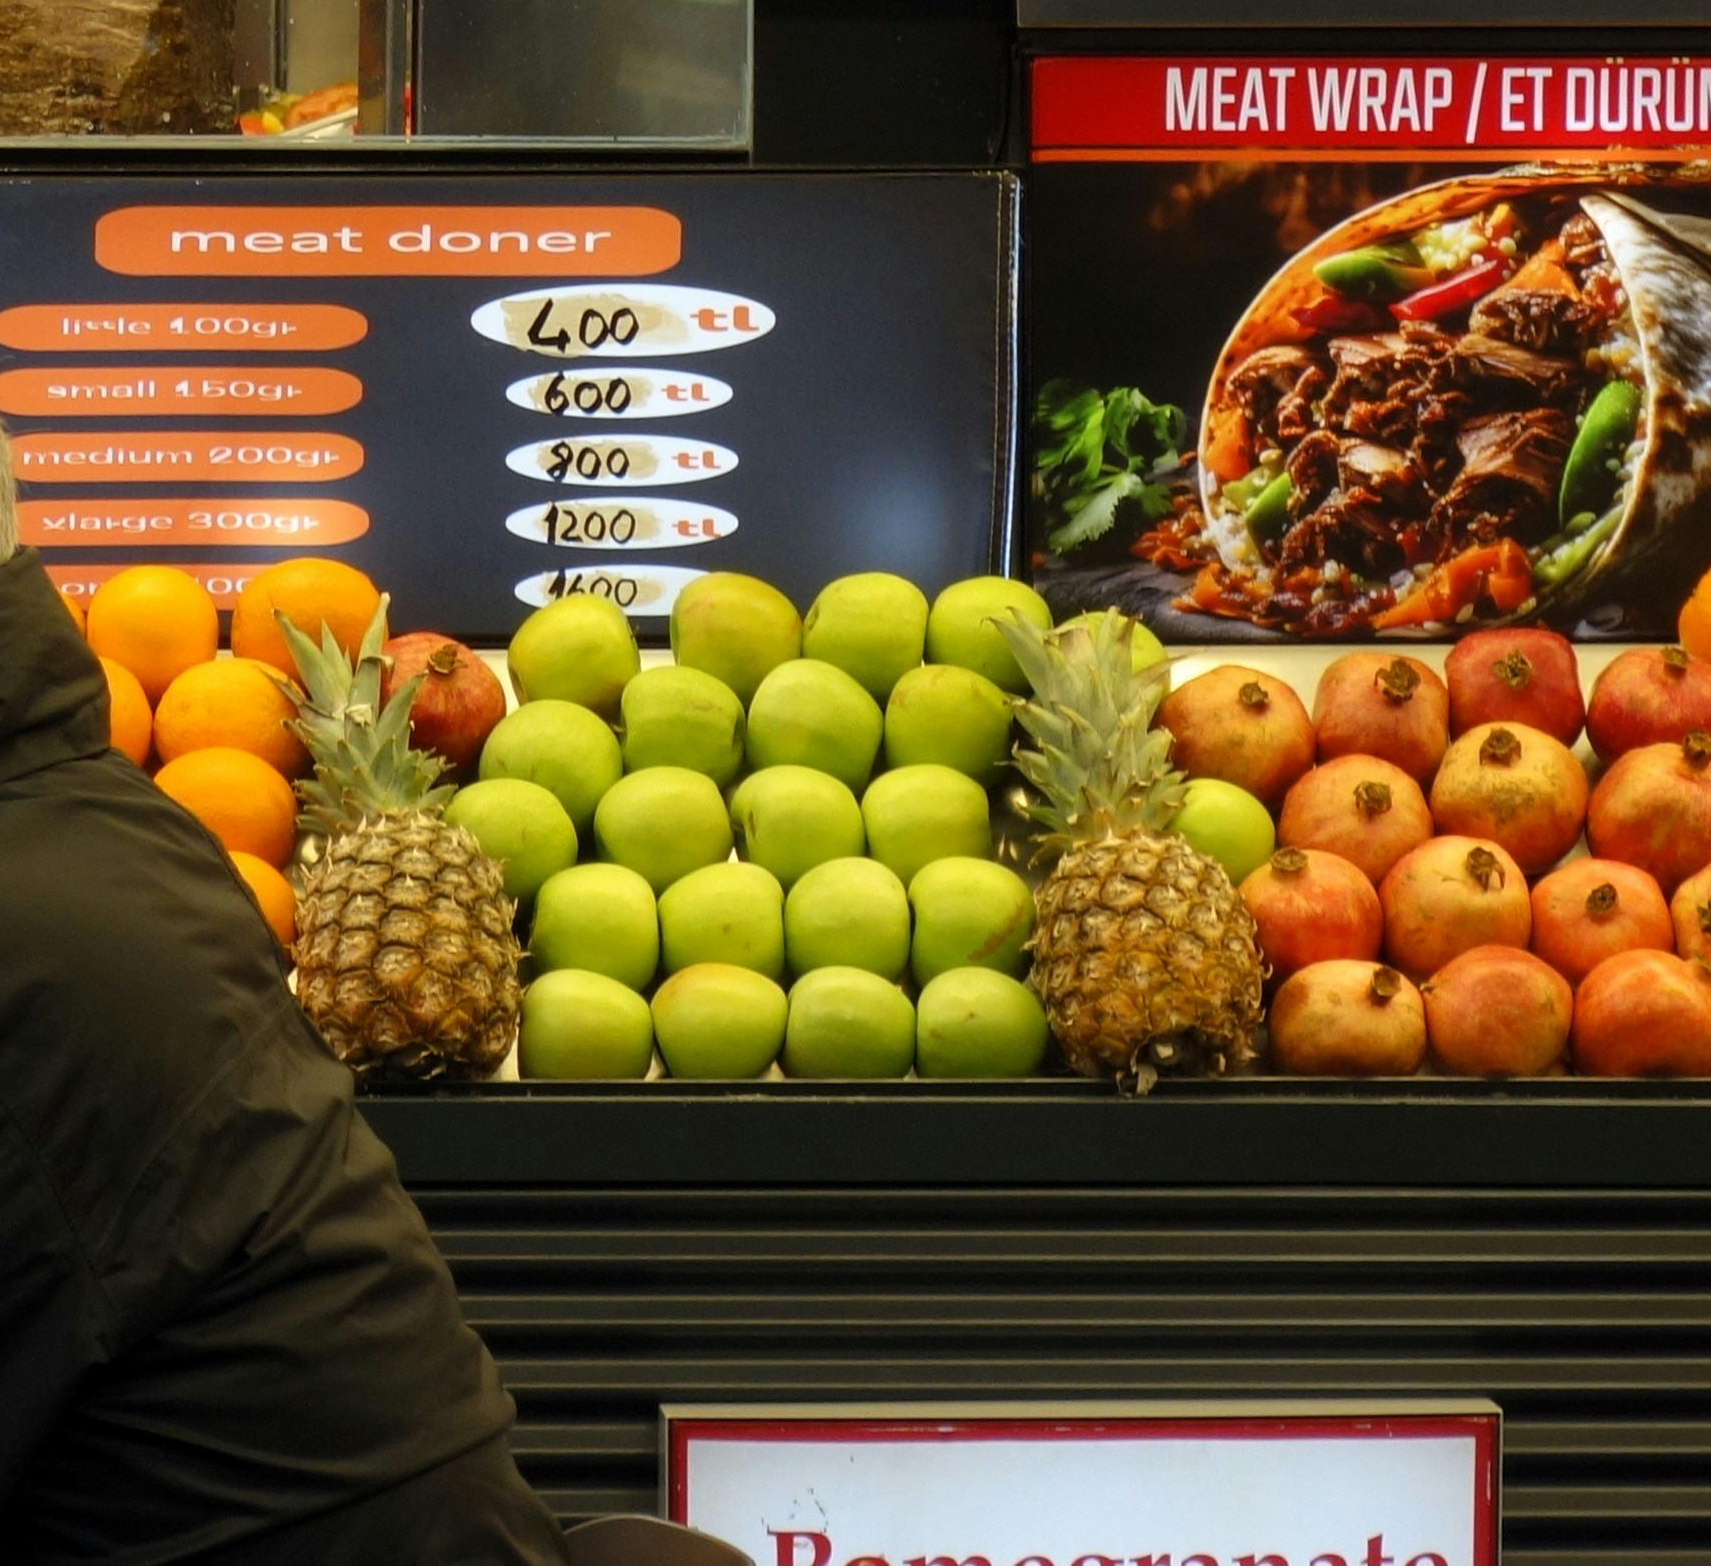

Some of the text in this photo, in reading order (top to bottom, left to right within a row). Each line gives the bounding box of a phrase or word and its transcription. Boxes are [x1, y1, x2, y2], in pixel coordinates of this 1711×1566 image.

[1165, 67, 1295, 131] MEAT
[1309, 67, 1453, 131] WRAP
[1466, 62, 1487, 144] /
[1501, 67, 1553, 131] ET
[171, 224, 612, 254] meat doner
[63, 316, 297, 338] little 100gr
[527, 298, 639, 354] 400
[47, 379, 302, 401] small 150gr
[544, 370, 632, 417] 600
[23, 446, 339, 468] medium 200gr
[546, 440, 629, 483] 800
[42, 511, 319, 534] xlarge 300gr
[543, 501, 636, 546] 1200
